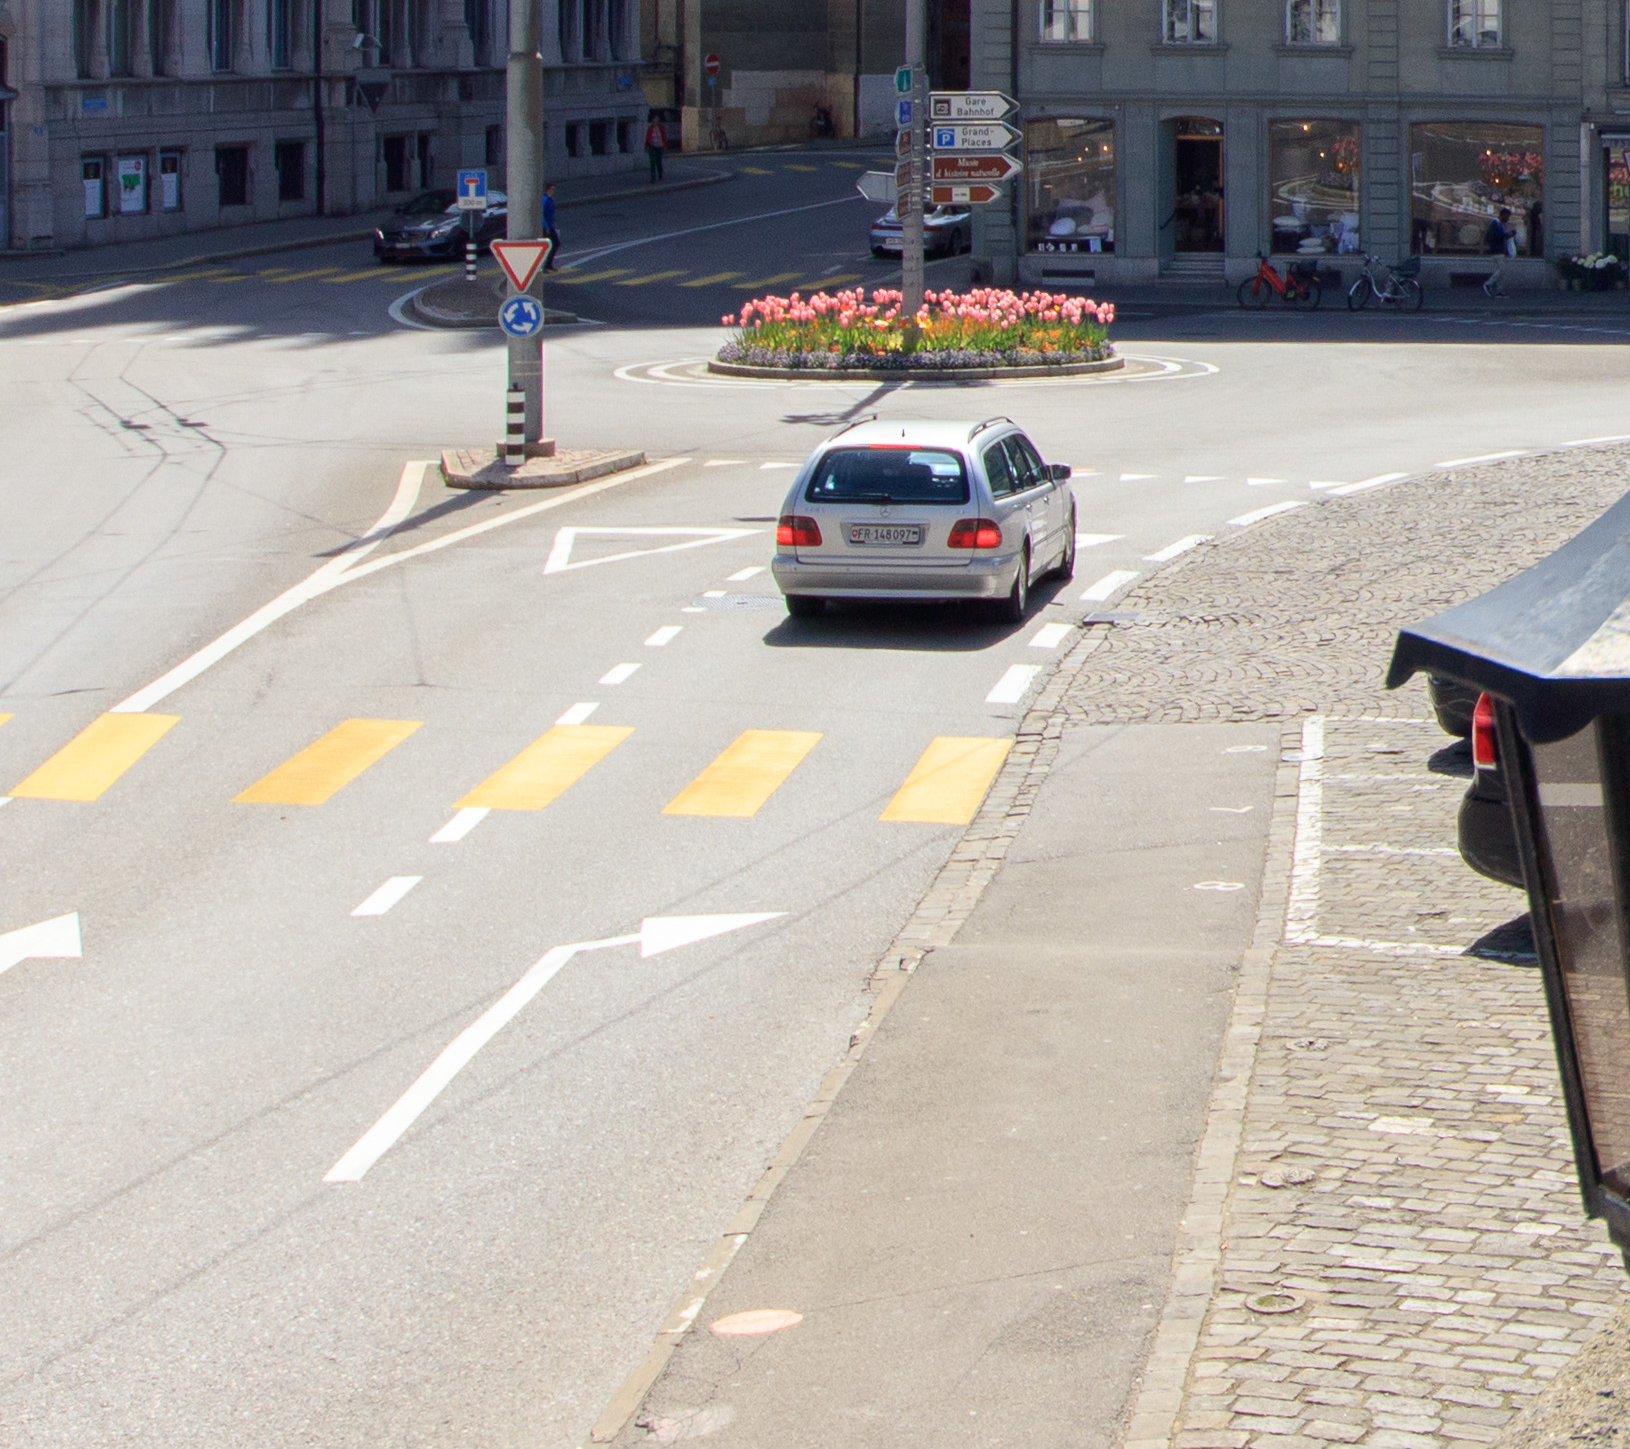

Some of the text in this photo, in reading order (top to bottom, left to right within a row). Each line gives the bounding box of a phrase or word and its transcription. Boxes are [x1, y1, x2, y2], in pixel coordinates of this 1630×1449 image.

[965, 96, 986, 106] Gare
[956, 107, 994, 116] Bahnhof
[962, 127, 994, 136] Grand-
[961, 138, 992, 146] Places
